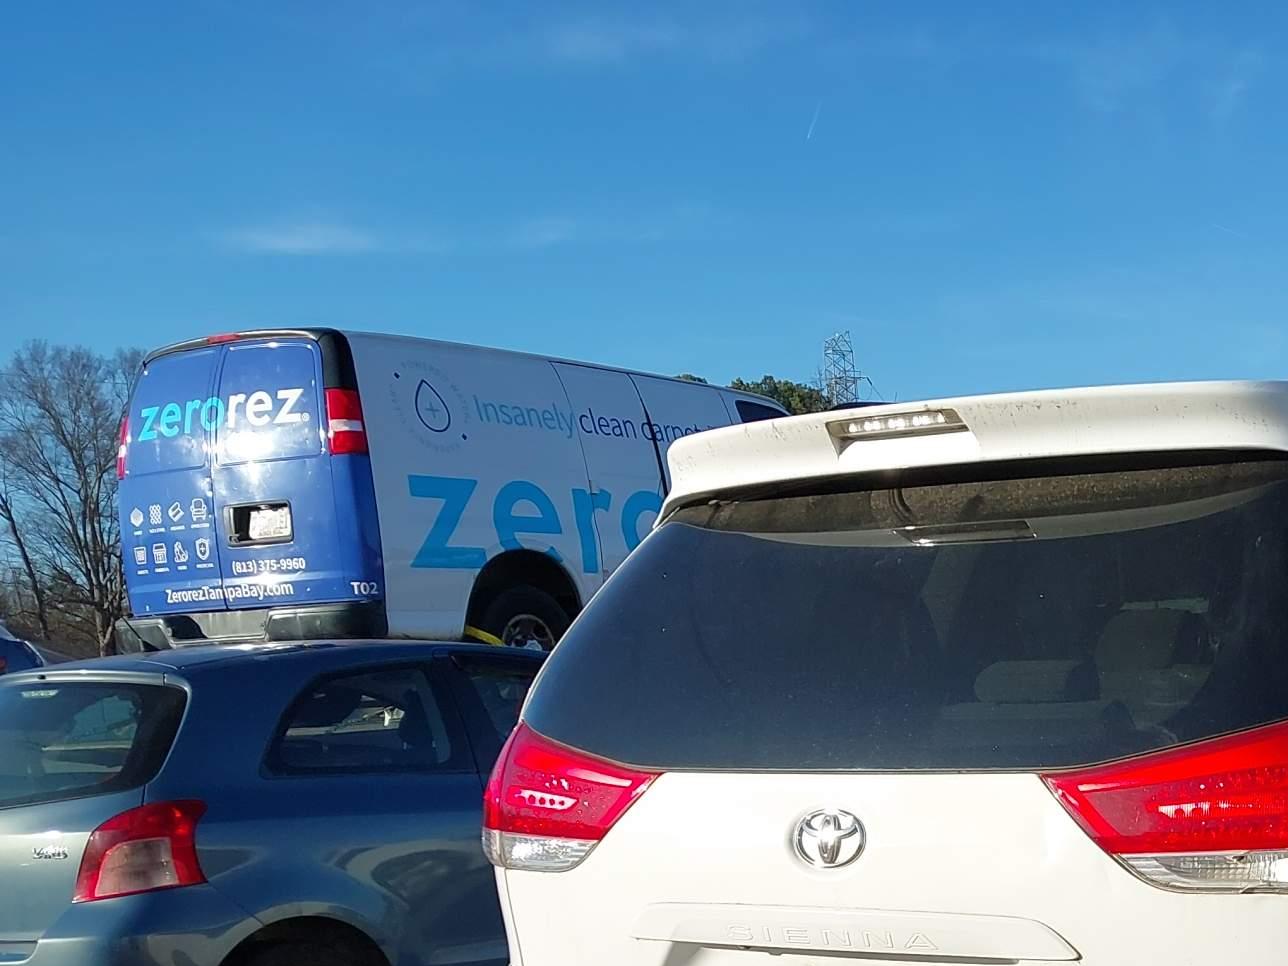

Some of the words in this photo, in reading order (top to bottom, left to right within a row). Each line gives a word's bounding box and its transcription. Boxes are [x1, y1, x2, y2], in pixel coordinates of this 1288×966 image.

[473, 395, 577, 439] Insanely
[579, 407, 638, 440] clean
[231, 560, 258, 576] (813)
[258, 557, 306, 571] 375-9960
[165, 582, 295, 604] ZerorezTampaBay.com
[726, 924, 940, 951] SIENNA
